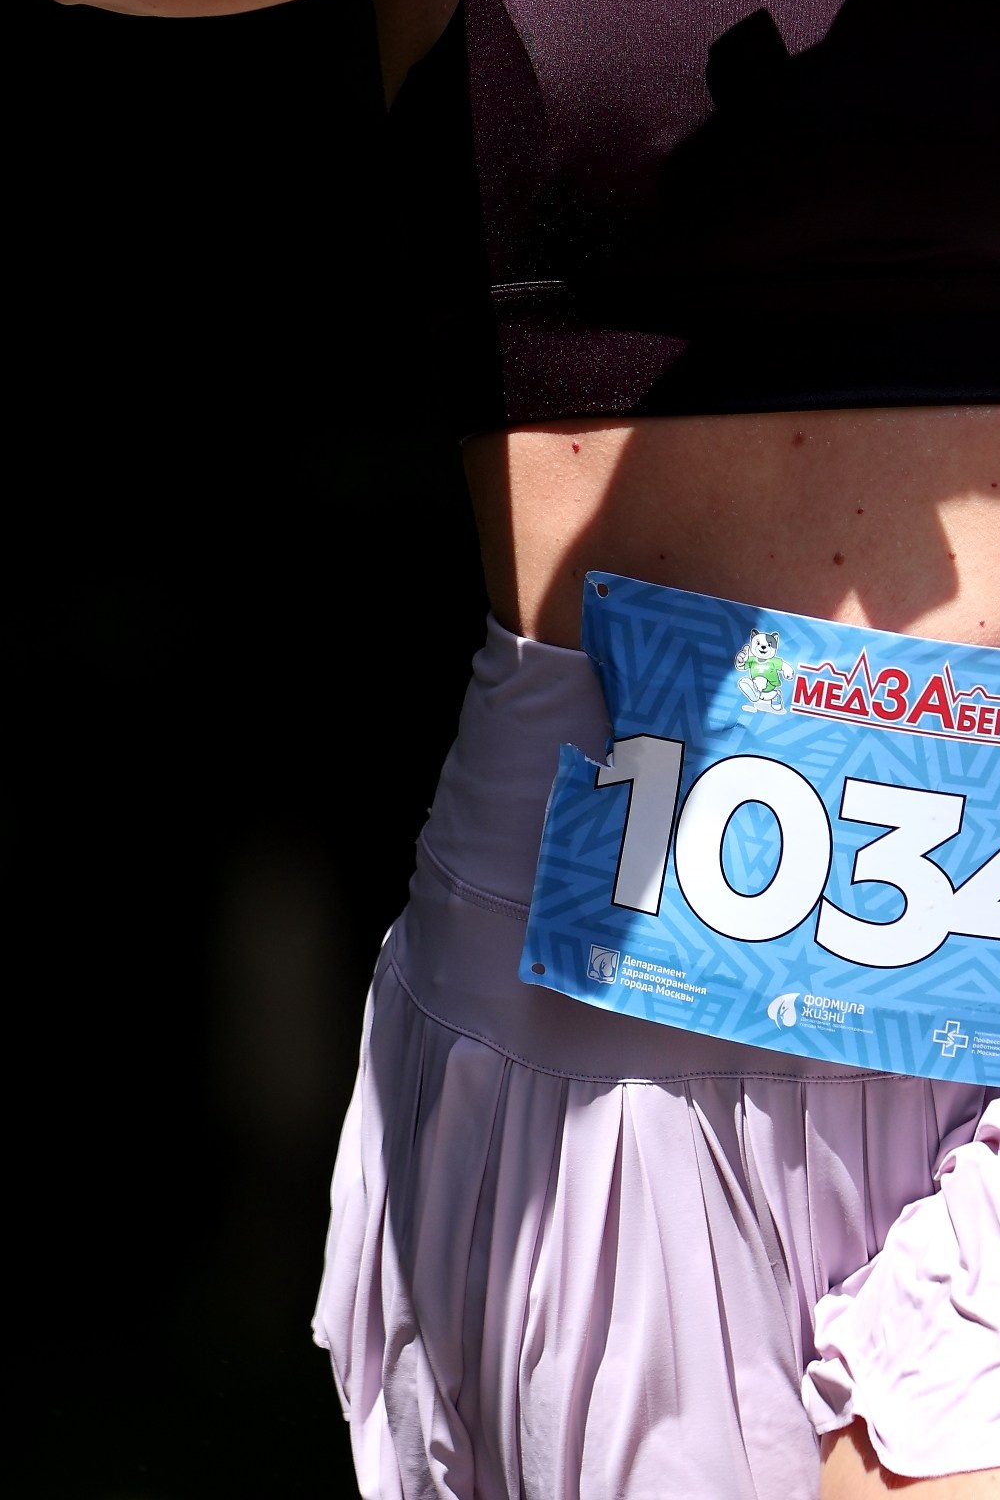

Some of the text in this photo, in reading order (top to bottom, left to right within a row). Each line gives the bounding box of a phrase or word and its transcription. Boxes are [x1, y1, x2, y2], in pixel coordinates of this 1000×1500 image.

[622, 955, 687, 979] Департамент
[620, 978, 694, 1002] города Москвы
[621, 968, 707, 995] здравоохранения
[803, 994, 865, 1015] формула
